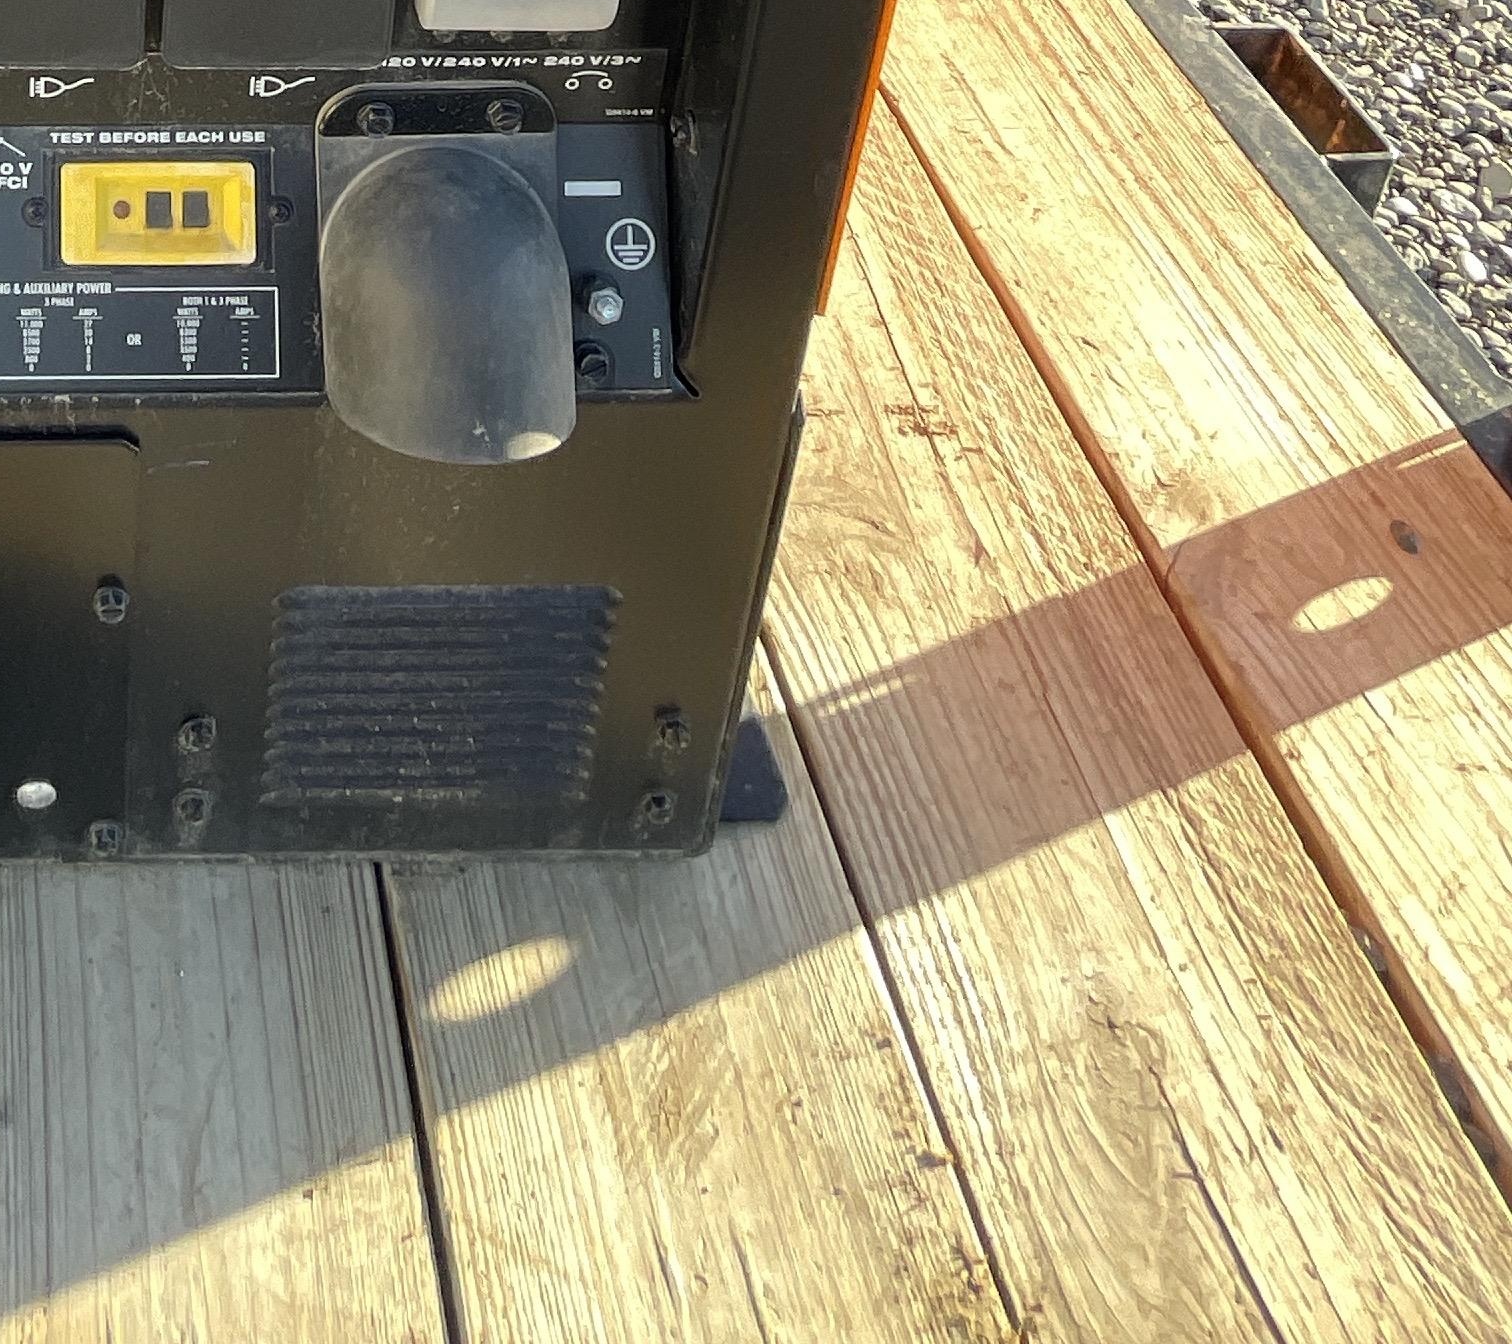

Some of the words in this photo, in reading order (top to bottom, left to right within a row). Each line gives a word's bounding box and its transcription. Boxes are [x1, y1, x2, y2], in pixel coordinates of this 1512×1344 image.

[544, 56, 585, 67] 240
[49, 132, 94, 144] TEST
[99, 131, 171, 144] BEFORE
[175, 131, 224, 144] EACH
[228, 131, 266, 143] USE
[18, 162, 33, 175] V
[23, 282, 74, 294] AUXILIARY
[76, 282, 112, 294] POWER
[126, 333, 142, 346] OR
